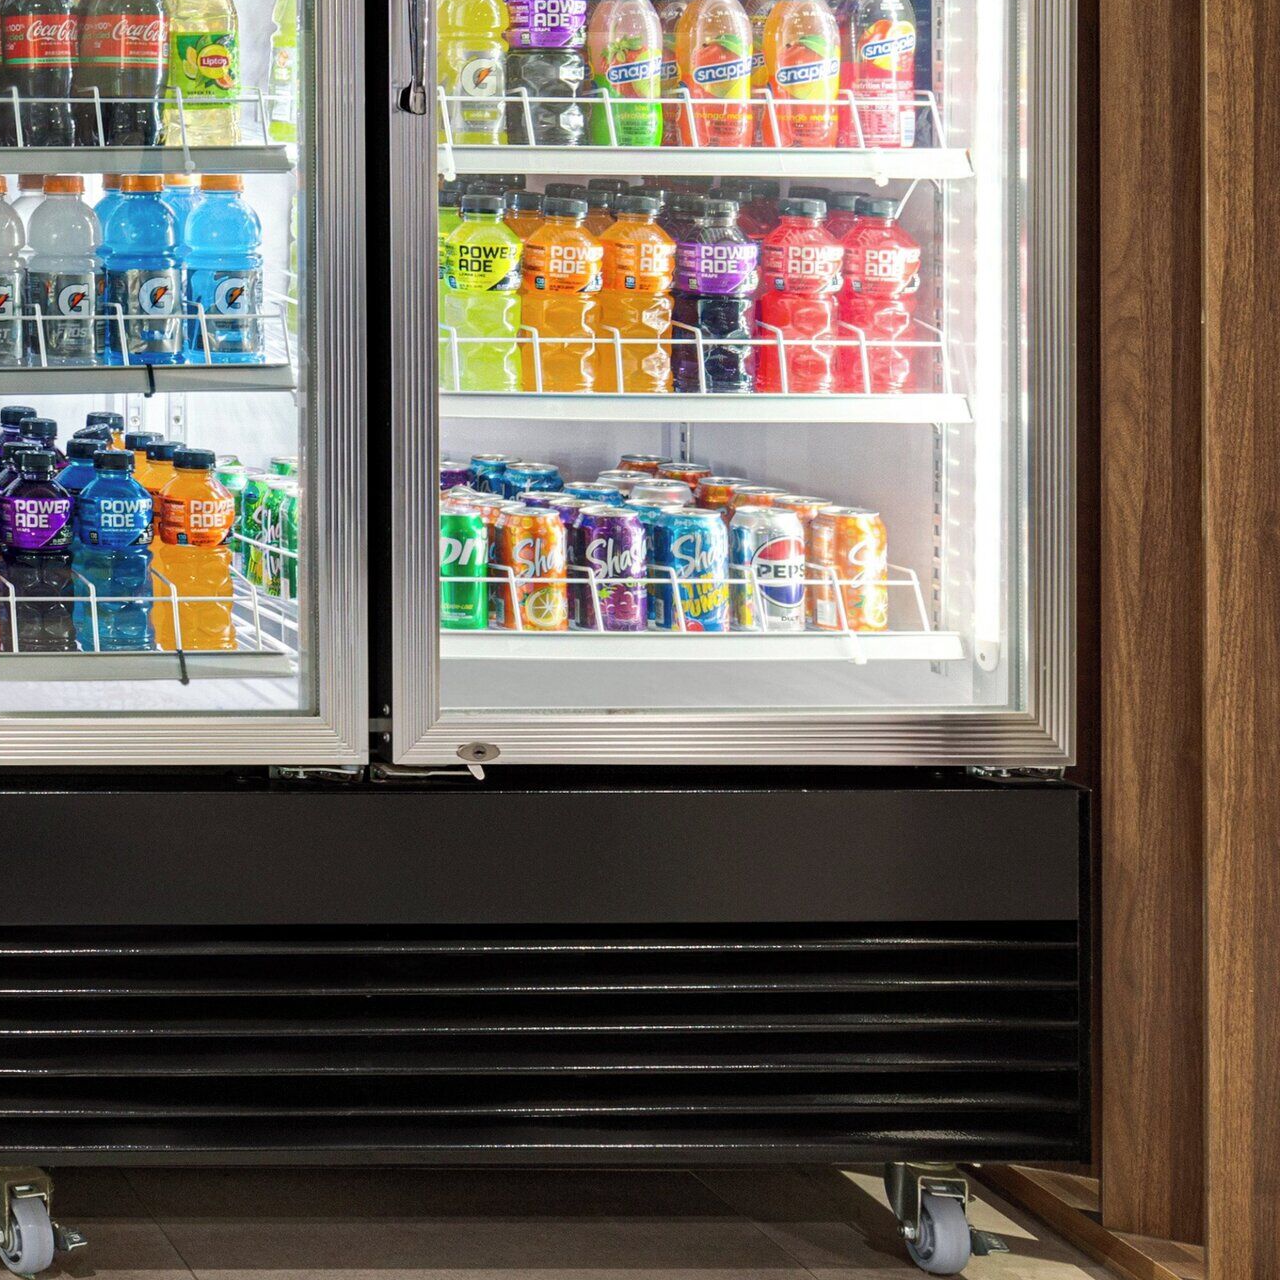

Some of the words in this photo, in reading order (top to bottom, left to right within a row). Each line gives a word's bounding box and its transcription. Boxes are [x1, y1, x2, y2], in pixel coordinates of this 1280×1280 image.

[202, 56, 227, 66] Lipton
[461, 58, 497, 97] G
[459, 260, 493, 273] ADE
[58, 284, 88, 318] G
[15, 500, 70, 514] POWER
[16, 514, 50, 528] ADE
[100, 514, 135, 528] ADE
